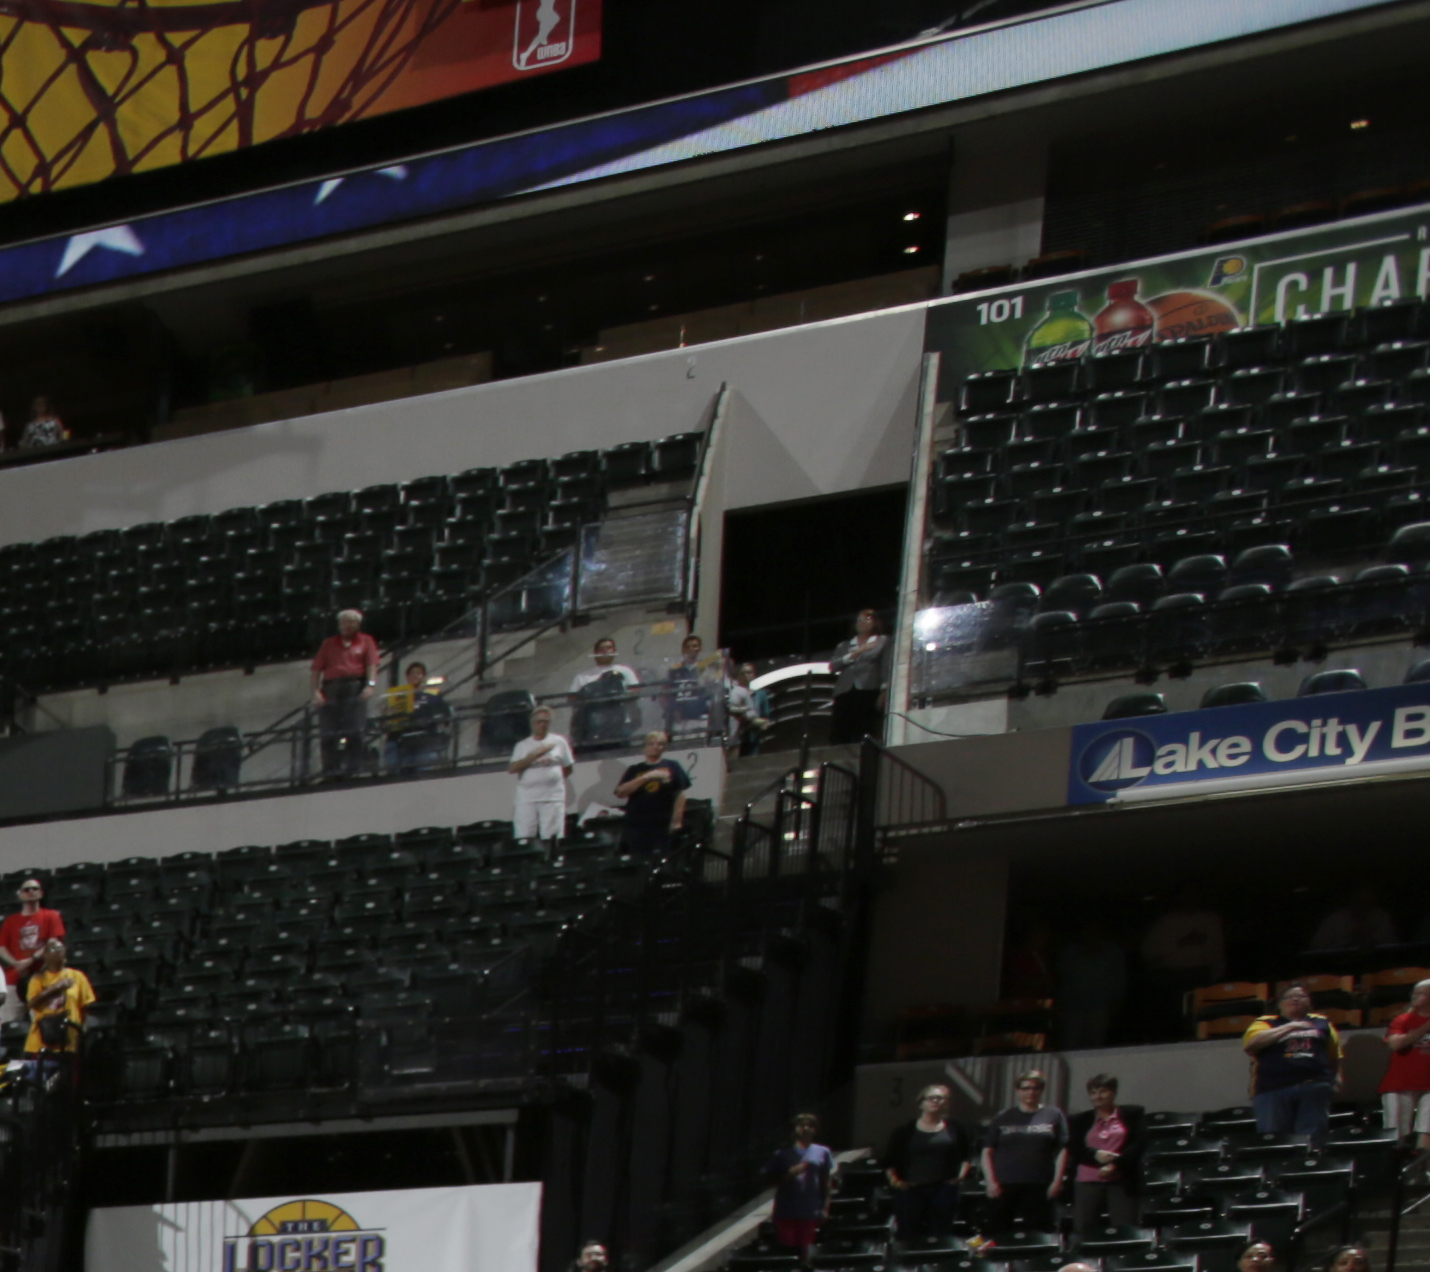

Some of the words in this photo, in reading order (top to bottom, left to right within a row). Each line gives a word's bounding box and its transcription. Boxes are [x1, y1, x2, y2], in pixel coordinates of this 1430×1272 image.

[977, 295, 1025, 324] 101
[1117, 729, 1254, 781] Lake
[1261, 716, 1380, 767] City
[285, 1220, 322, 1232] THE
